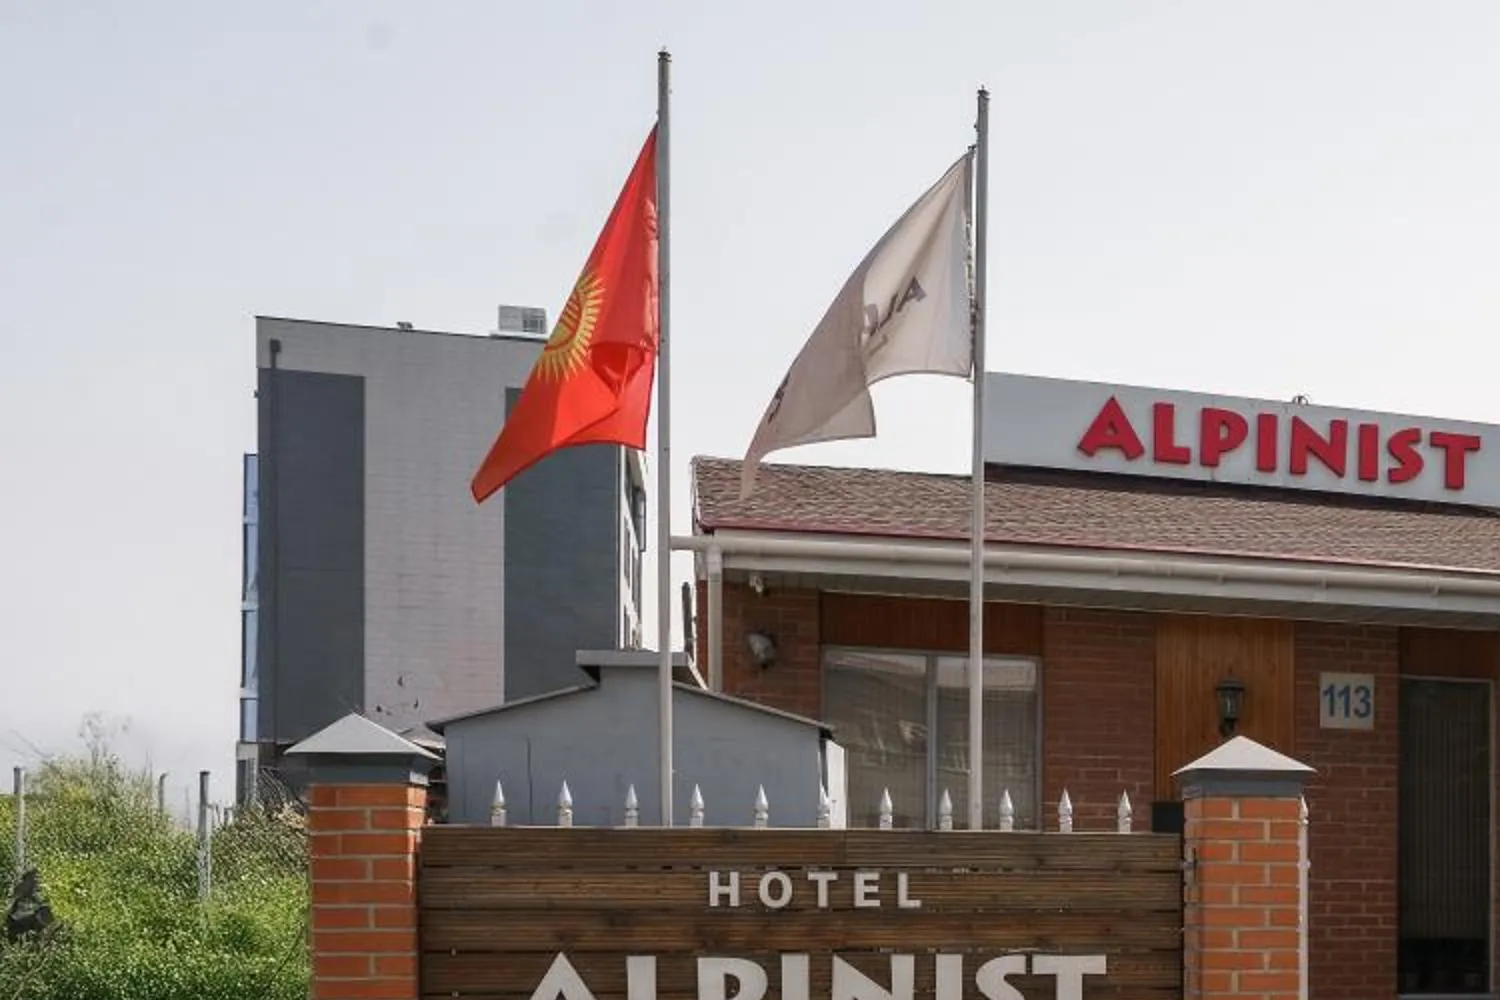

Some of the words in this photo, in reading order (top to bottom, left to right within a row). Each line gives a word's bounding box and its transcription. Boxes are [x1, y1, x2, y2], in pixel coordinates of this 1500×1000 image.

[1077, 396, 1481, 490] ALPINIST
[1323, 684, 1371, 718] 113
[710, 872, 920, 907] HOTEL
